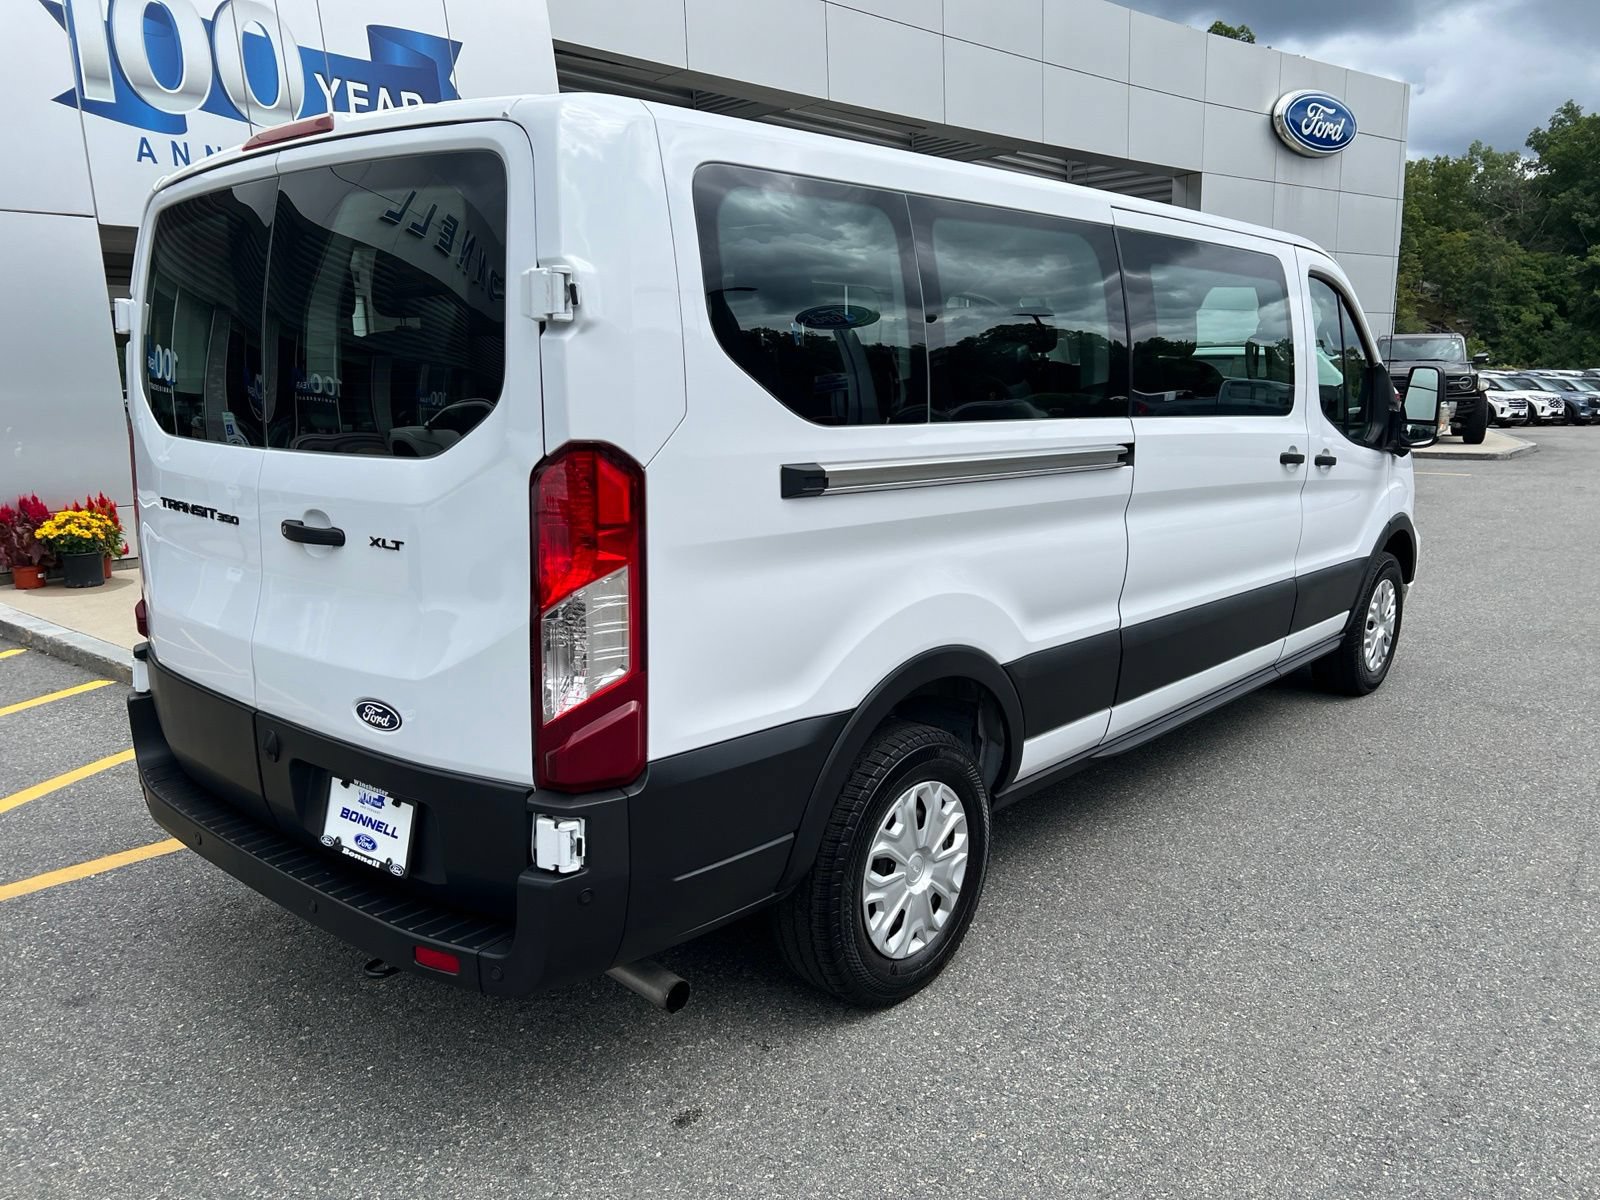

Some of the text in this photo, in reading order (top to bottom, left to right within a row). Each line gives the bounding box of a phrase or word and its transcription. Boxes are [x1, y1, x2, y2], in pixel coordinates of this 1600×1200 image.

[65, 0, 305, 127] 100
[1301, 102, 1346, 142] Ford
[160, 496, 218, 520] TRANSIT
[368, 535, 405, 551] XLT
[362, 704, 391, 727] Ford
[340, 806, 399, 839] BONNELL
[357, 834, 375, 850] Ford
[341, 847, 380, 869] Bonnell
